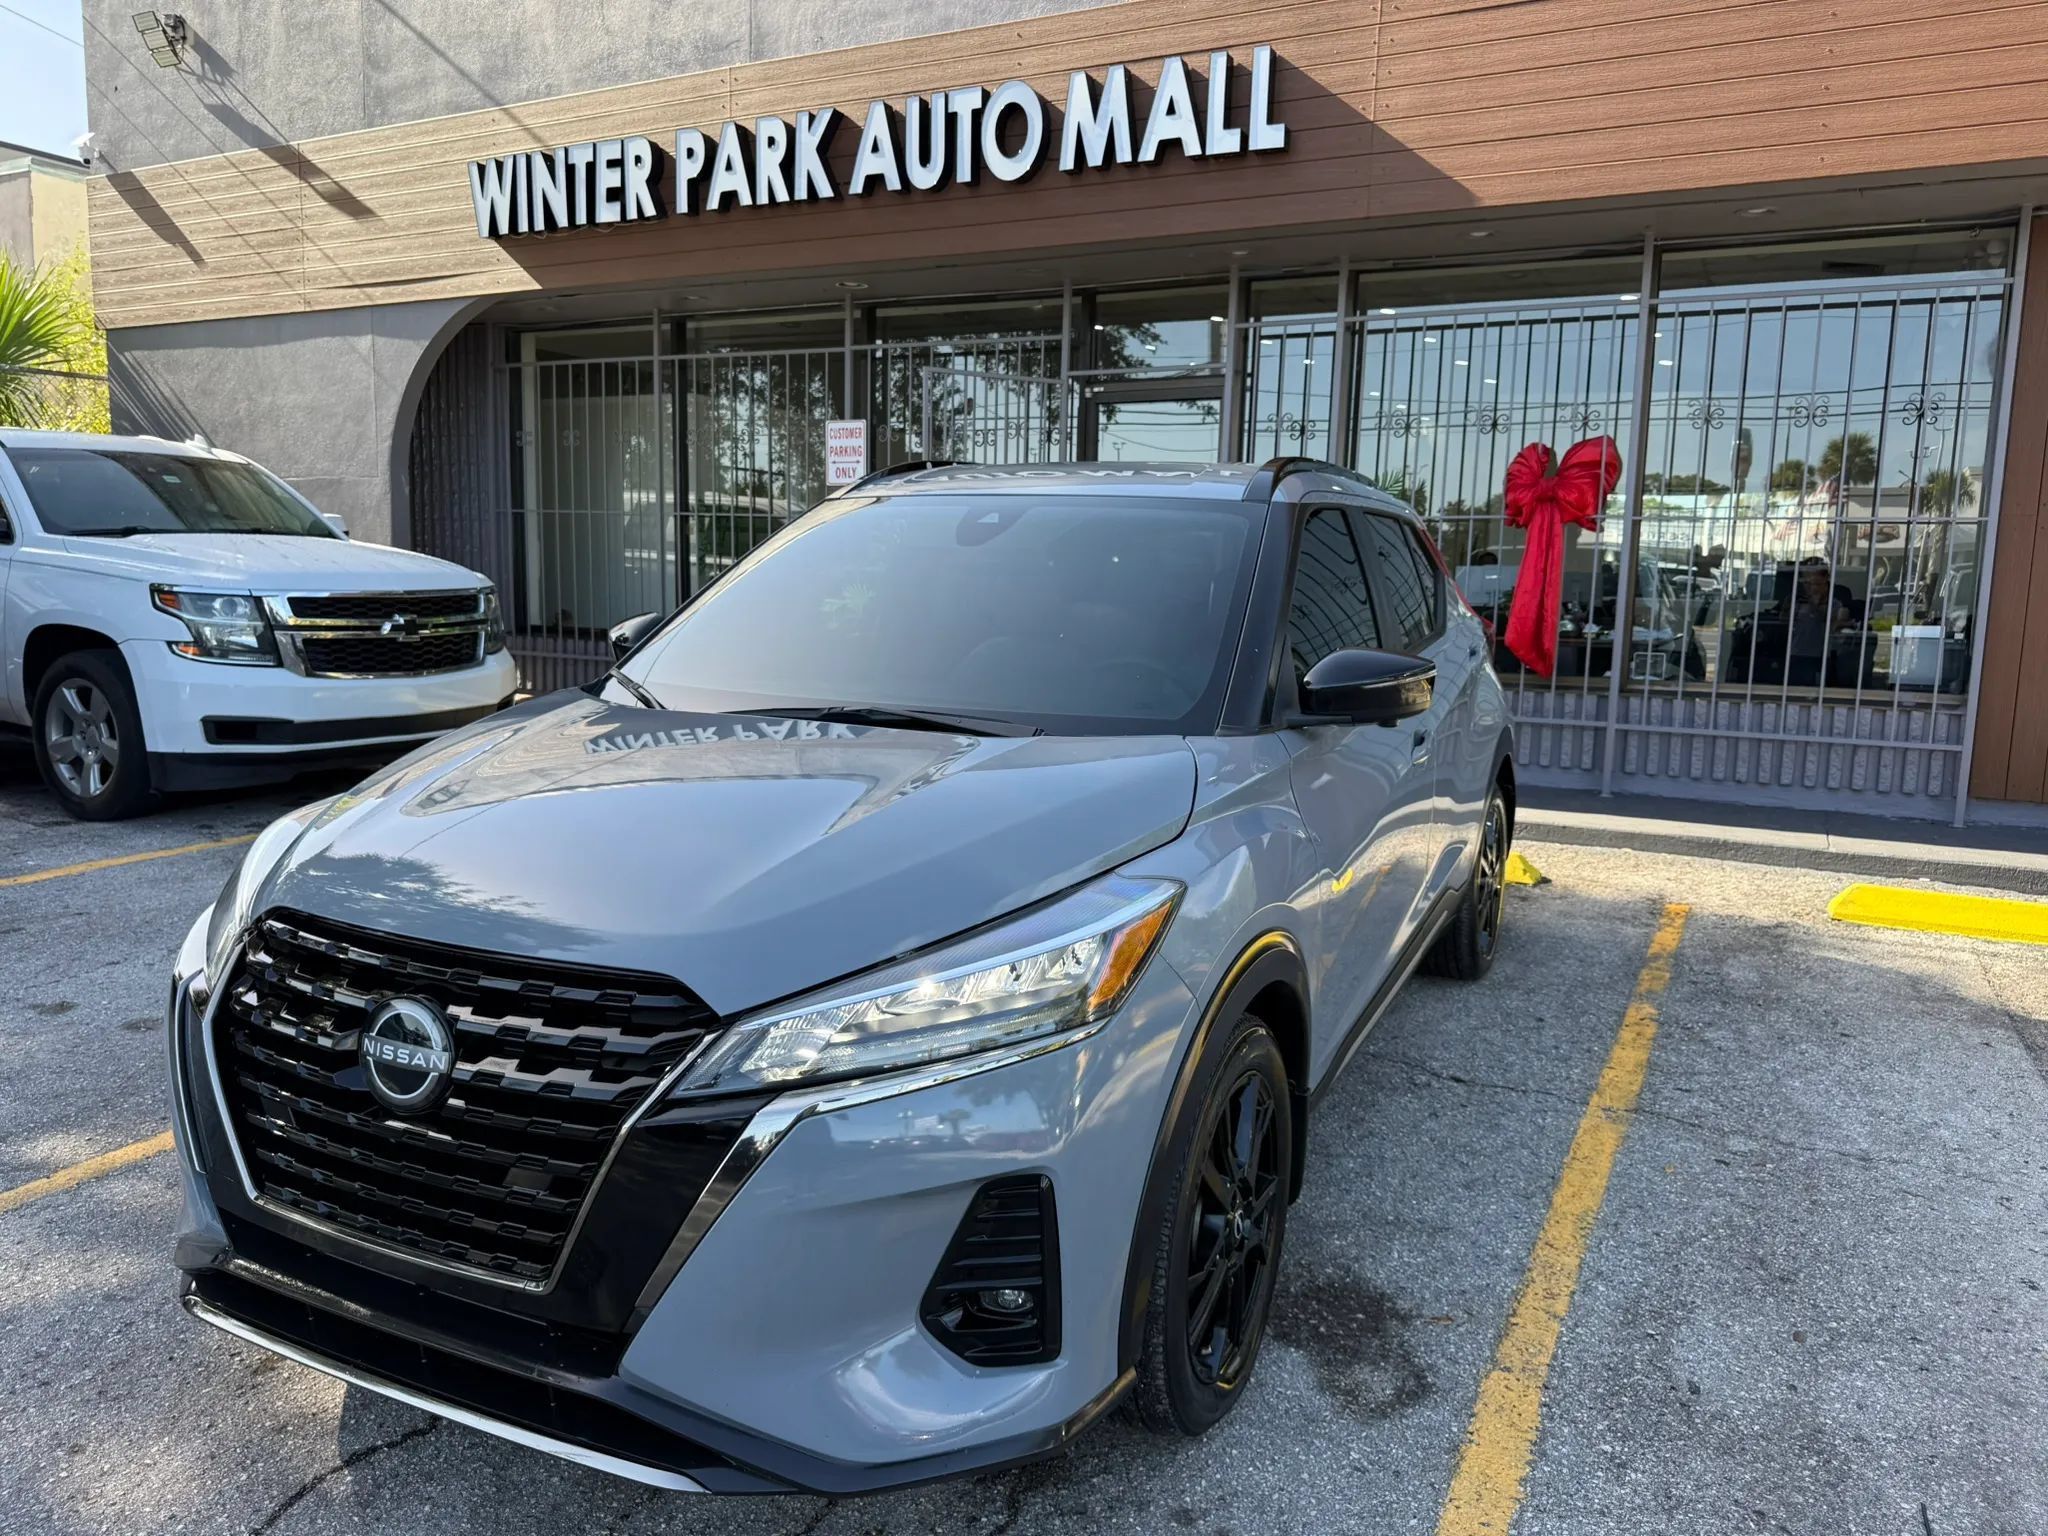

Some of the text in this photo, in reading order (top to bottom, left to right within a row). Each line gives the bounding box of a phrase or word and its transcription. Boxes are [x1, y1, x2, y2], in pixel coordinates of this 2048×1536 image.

[468, 45, 1287, 238] WINTER PARK AUTO MALL
[829, 428, 863, 440] CUSTOMER
[829, 445, 863, 457] PARKING
[835, 467, 857, 479] ONLY
[363, 1037, 446, 1070] NISSAN
